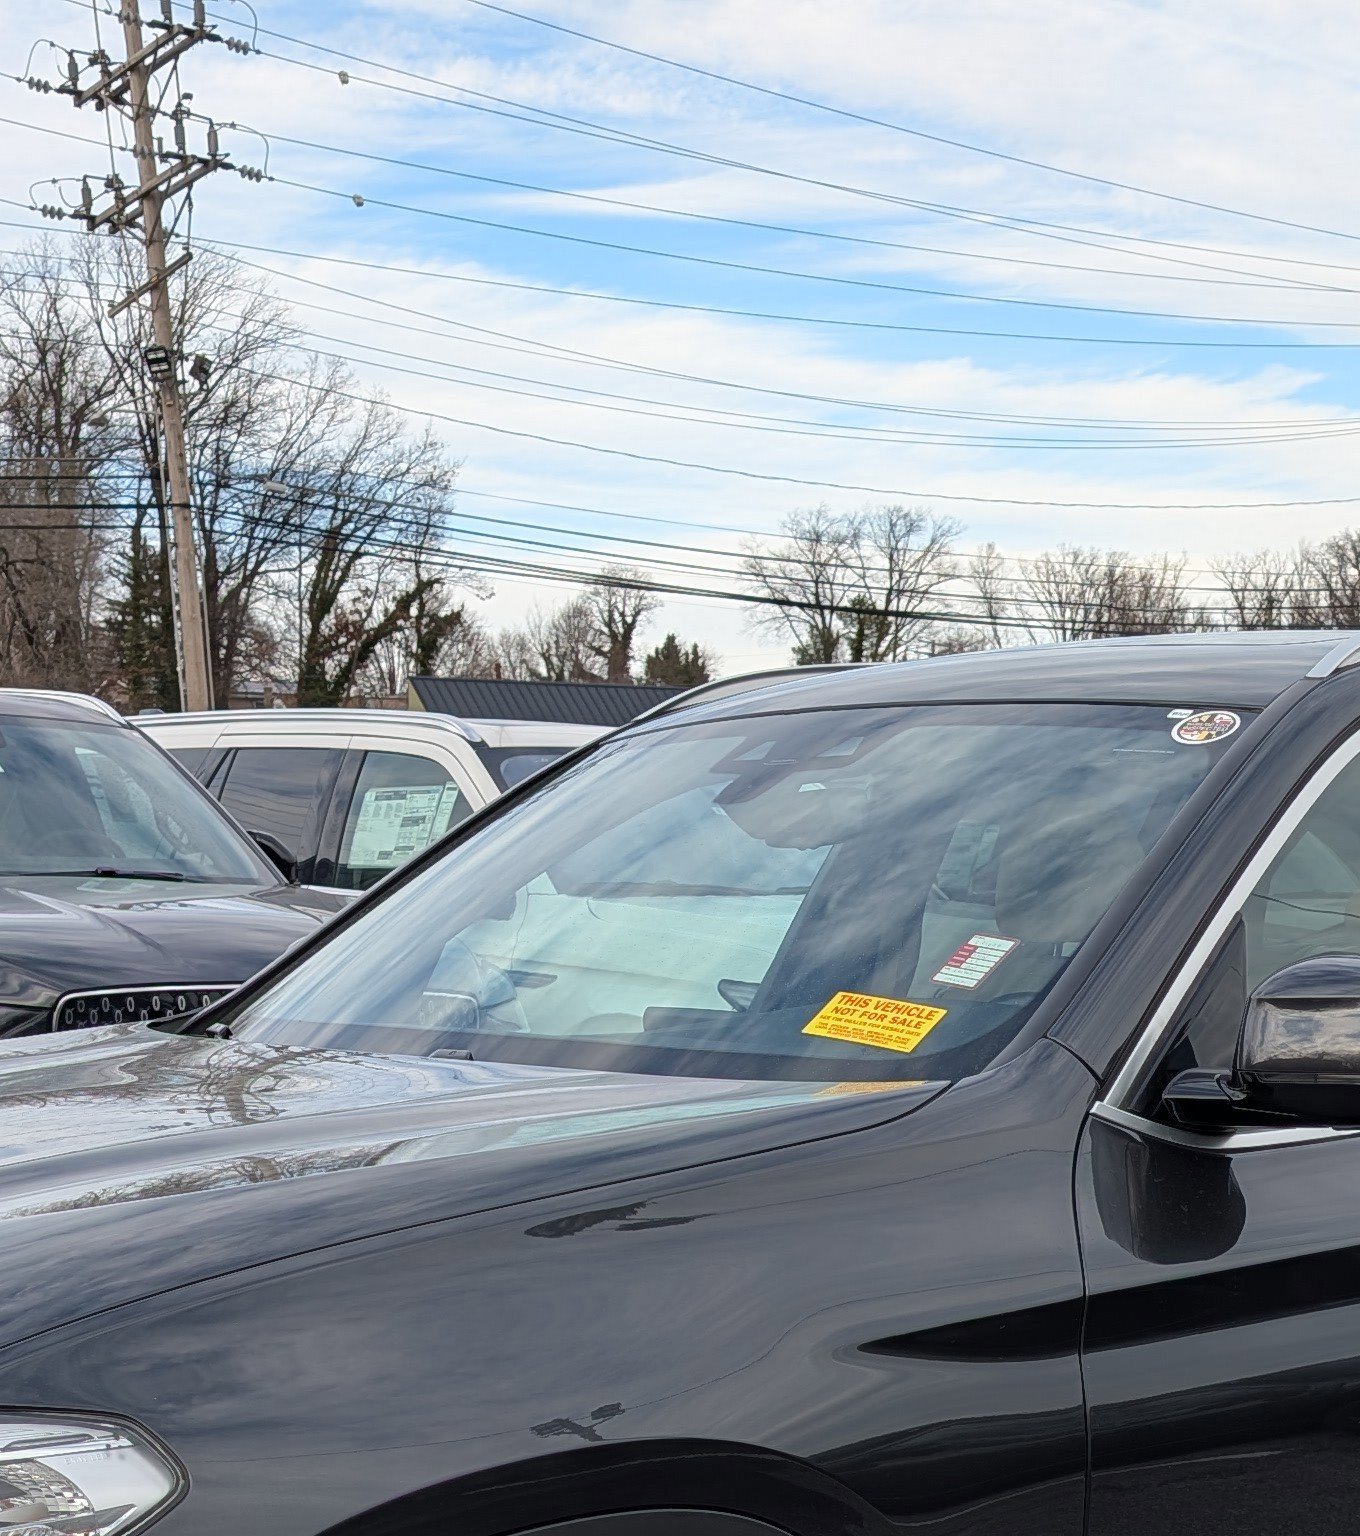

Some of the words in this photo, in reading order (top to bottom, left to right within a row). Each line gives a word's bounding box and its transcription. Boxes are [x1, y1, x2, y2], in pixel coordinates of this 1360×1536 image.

[830, 1006, 860, 1016] NOT
[859, 1010, 888, 1022] FOR
[888, 1016, 926, 1030] SALE
[837, 994, 872, 1008] THIS
[873, 1000, 939, 1020] VEHICLE
